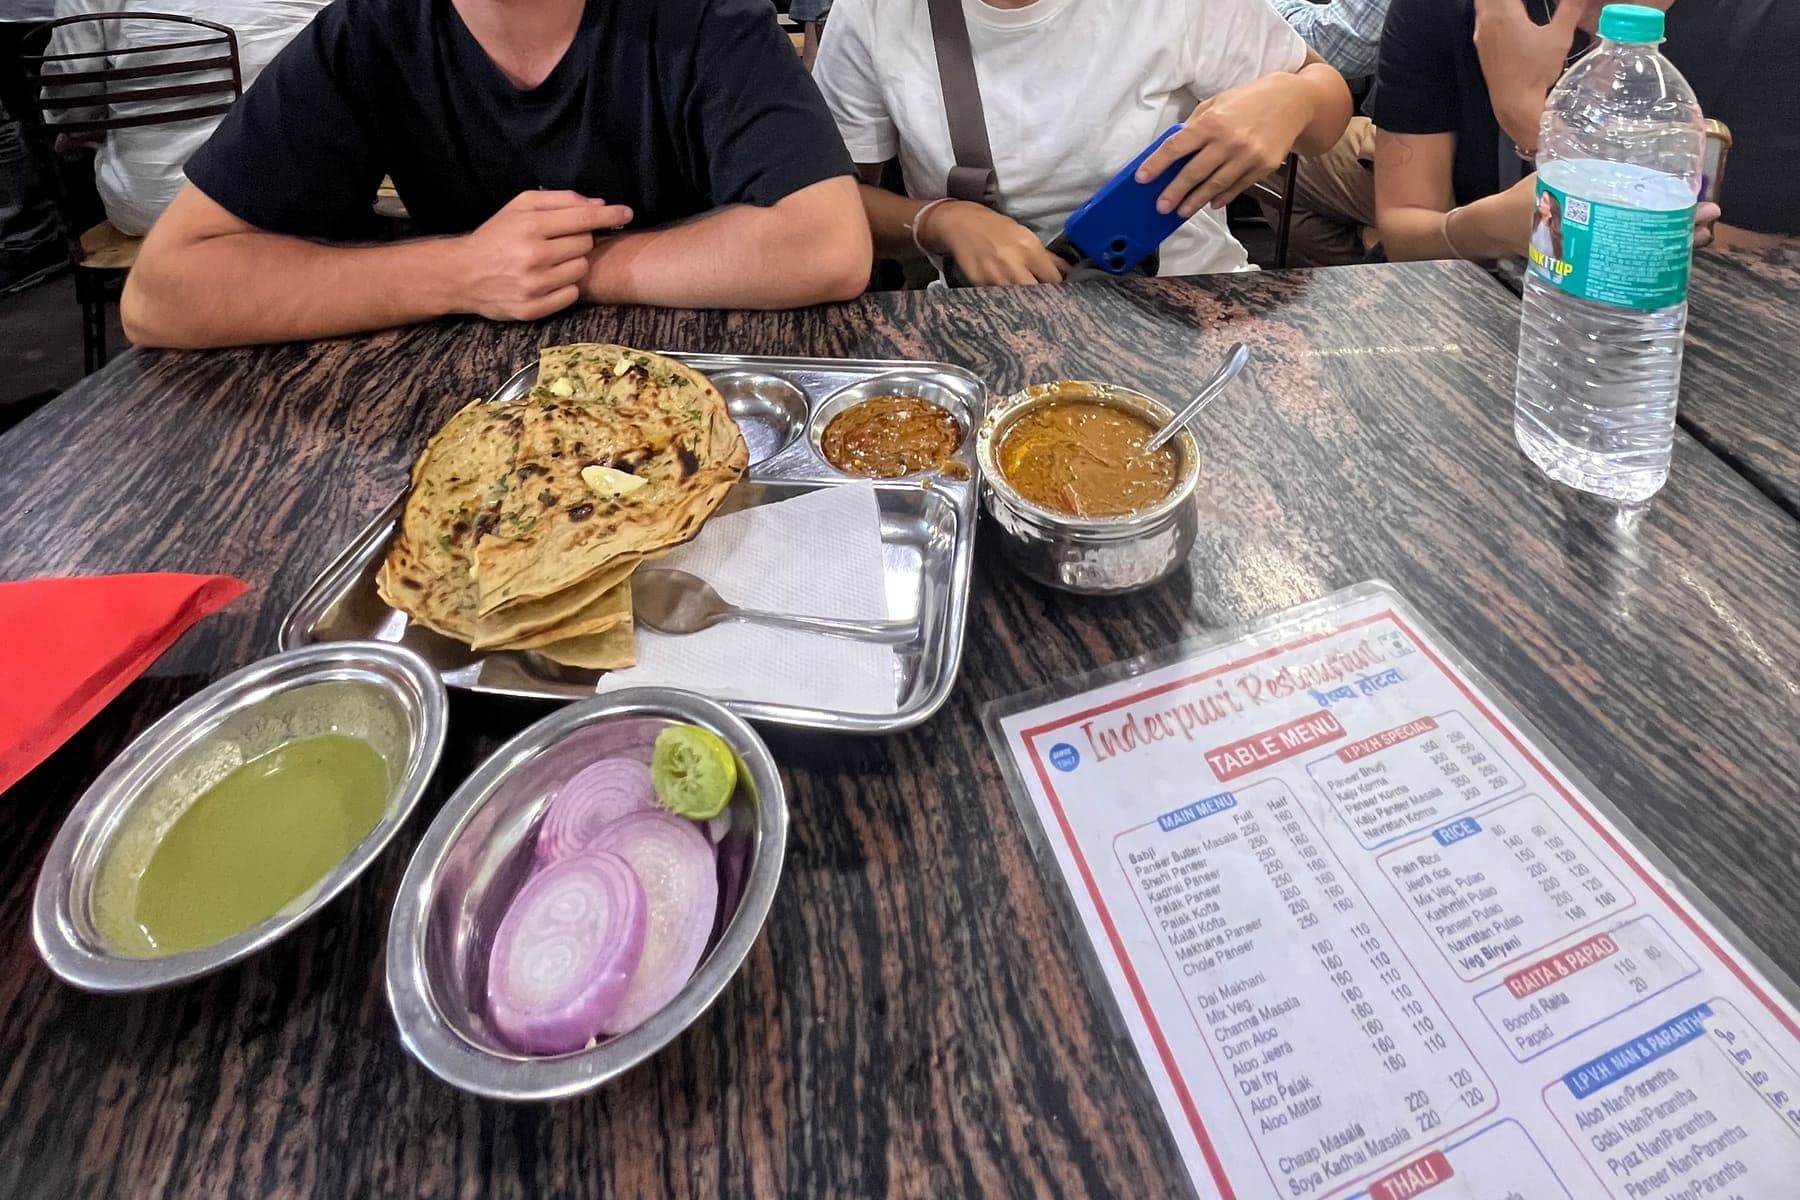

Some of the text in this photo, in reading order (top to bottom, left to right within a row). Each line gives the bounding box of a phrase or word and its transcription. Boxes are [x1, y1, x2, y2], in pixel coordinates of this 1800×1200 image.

[1080, 679, 1243, 762] Inderpuri
[1208, 714, 1340, 775] TABLE MENU
[1382, 721, 1433, 746] SPECIAL
[1161, 795, 1235, 828] MAIN MENU
[1233, 810, 1254, 824] Full
[1267, 796, 1288, 812] Half
[1439, 821, 1475, 843] RICE
[1135, 857, 1170, 877] Paneer
[1202, 833, 1238, 851] Masala
[1240, 822, 1260, 837] 250
[1172, 858, 1208, 878] Paneer
[1248, 835, 1268, 850] 250
[1185, 869, 1220, 888] Paneer
[1256, 847, 1276, 862] 250
[1515, 849, 1536, 863] 150
[1556, 850, 1576, 864] 120
[1569, 864, 1590, 878] 120
[1154, 898, 1184, 918] Palak
[1185, 884, 1222, 904] Paneer
[1264, 859, 1283, 875] 250
[1161, 911, 1191, 932] Palak
[1272, 872, 1292, 888] 250
[1200, 916, 1226, 935] Kofta
[1280, 885, 1300, 901] 250
[1225, 917, 1263, 940] Paneer
[1289, 898, 1310, 915] 250
[1183, 955, 1215, 977] Chole
[1216, 939, 1255, 963] Paneer
[1297, 913, 1319, 930] 250
[1198, 922, 1370, 1009] Dal Makhani 110
[1459, 954, 1483, 971] Veg
[1510, 965, 1558, 997] RAITA
[1555, 961, 1569, 976] &
[1565, 937, 1615, 968] PAPAD
[1206, 1009, 1228, 1025] Mix
[1360, 937, 1380, 954] 110
[1259, 996, 1300, 1022] Masala
[1370, 951, 1390, 970] 110
[1502, 1003, 1542, 1033] Boondi
[1614, 957, 1636, 976] 110
[1222, 968, 1401, 1060] Dum Aloo 110
[1232, 1058, 1259, 1078] Aloo
[1263, 1041, 1293, 1064] Jeera
[1391, 984, 1412, 1001] 110
[1515, 976, 1648, 1051] Papad 20
[1240, 1077, 1263, 1096] Dal
[1402, 1000, 1423, 1018] 110
[1250, 1095, 1278, 1115] Aloo
[1278, 1075, 1313, 1101] Palak
[1413, 1016, 1434, 1036] 110
[1610, 1046, 1640, 1071] NAN
[1638, 1042, 1650, 1057] &
[1260, 1114, 1288, 1135] Aloo
[1287, 1094, 1323, 1120] Matar
[1425, 1033, 1446, 1054] 110
[1575, 1067, 1679, 1131] Aloo Nan/Parantha
[1278, 1068, 1472, 1175] Chaap Masala 220 120
[1289, 1087, 1485, 1197] Soya Kadhai Masala 220 120
[1591, 1087, 1698, 1153] Gobi Nan/Parantha
[1606, 1109, 1718, 1177] Pyaz Nan/Parantha
[1382, 1160, 1438, 1200] THALI
[1624, 1125, 1748, 1200] Paneer Nan/Parantha
